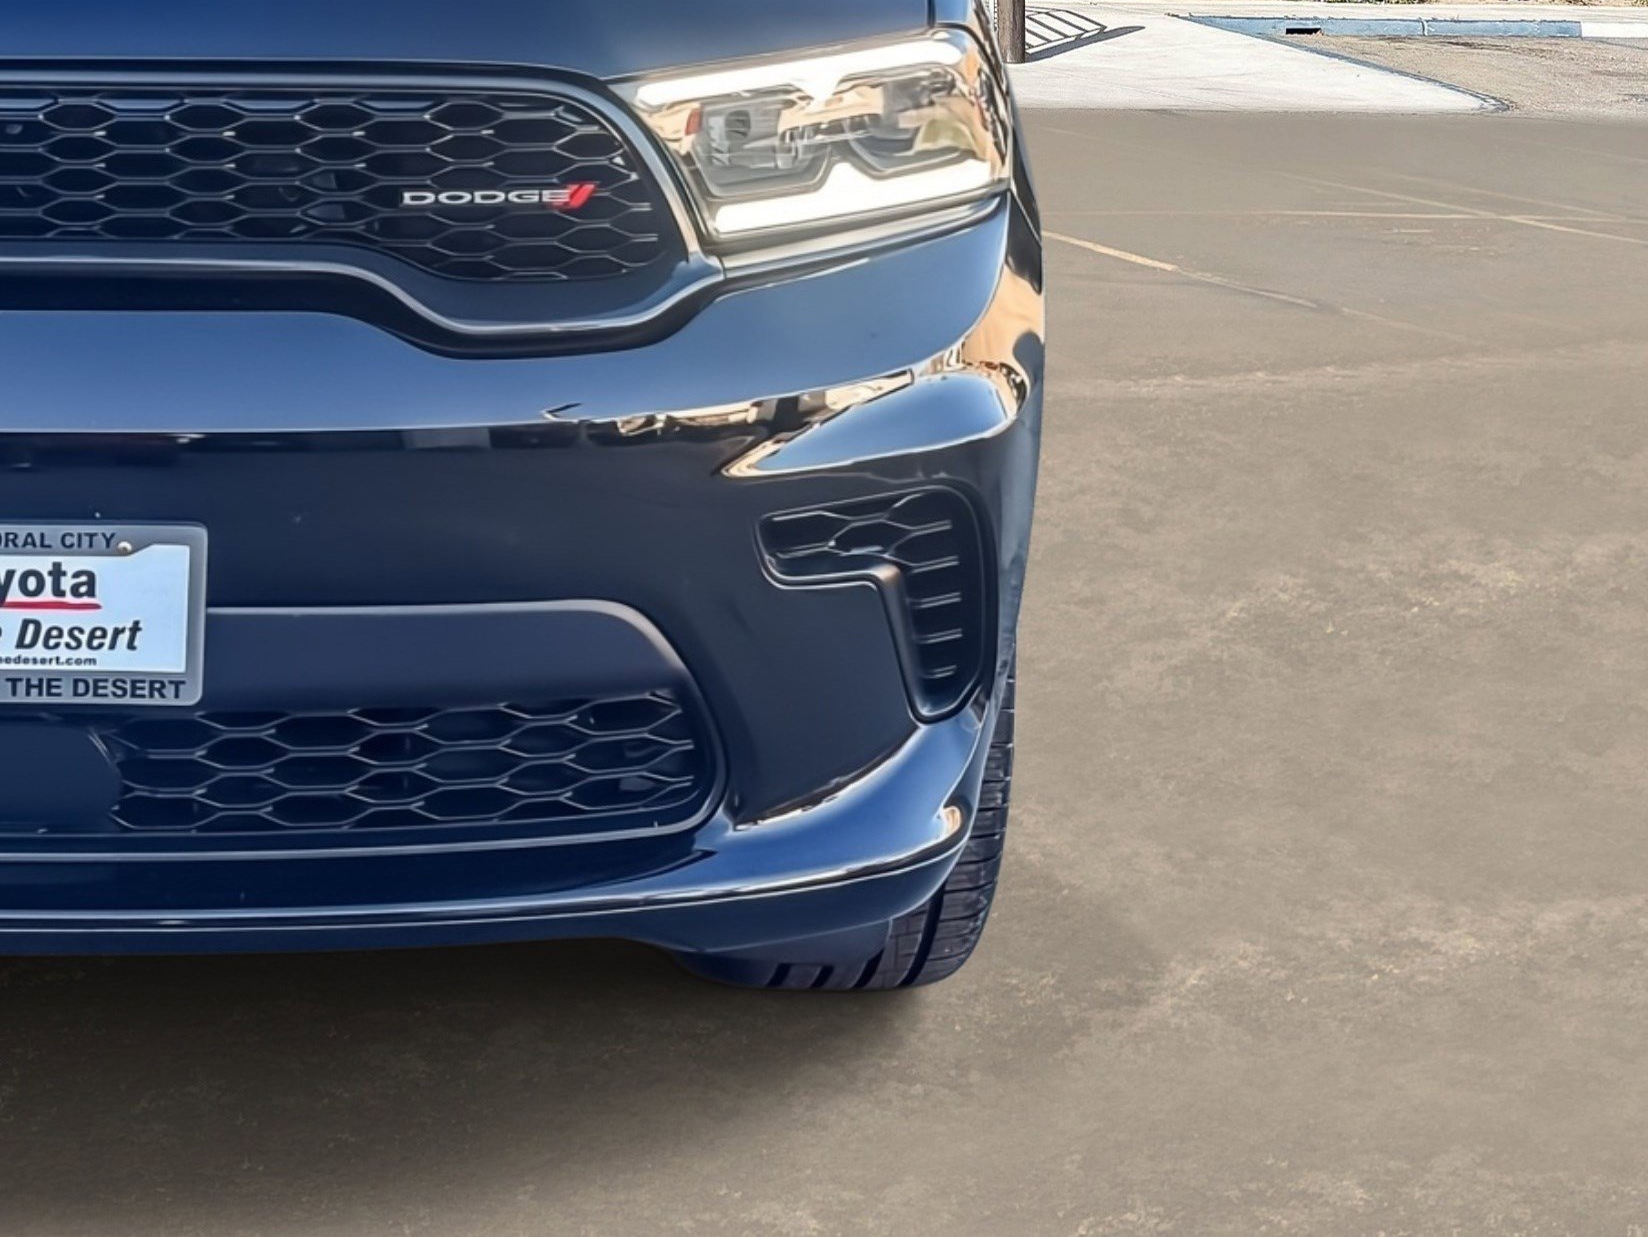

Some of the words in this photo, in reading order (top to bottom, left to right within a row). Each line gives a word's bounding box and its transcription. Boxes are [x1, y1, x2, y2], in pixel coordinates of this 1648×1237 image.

[403, 189, 571, 205] DODGE
[61, 532, 117, 550] CITY
[15, 618, 142, 651] Desert
[5, 677, 63, 698] THE
[72, 678, 186, 699] DESERT
